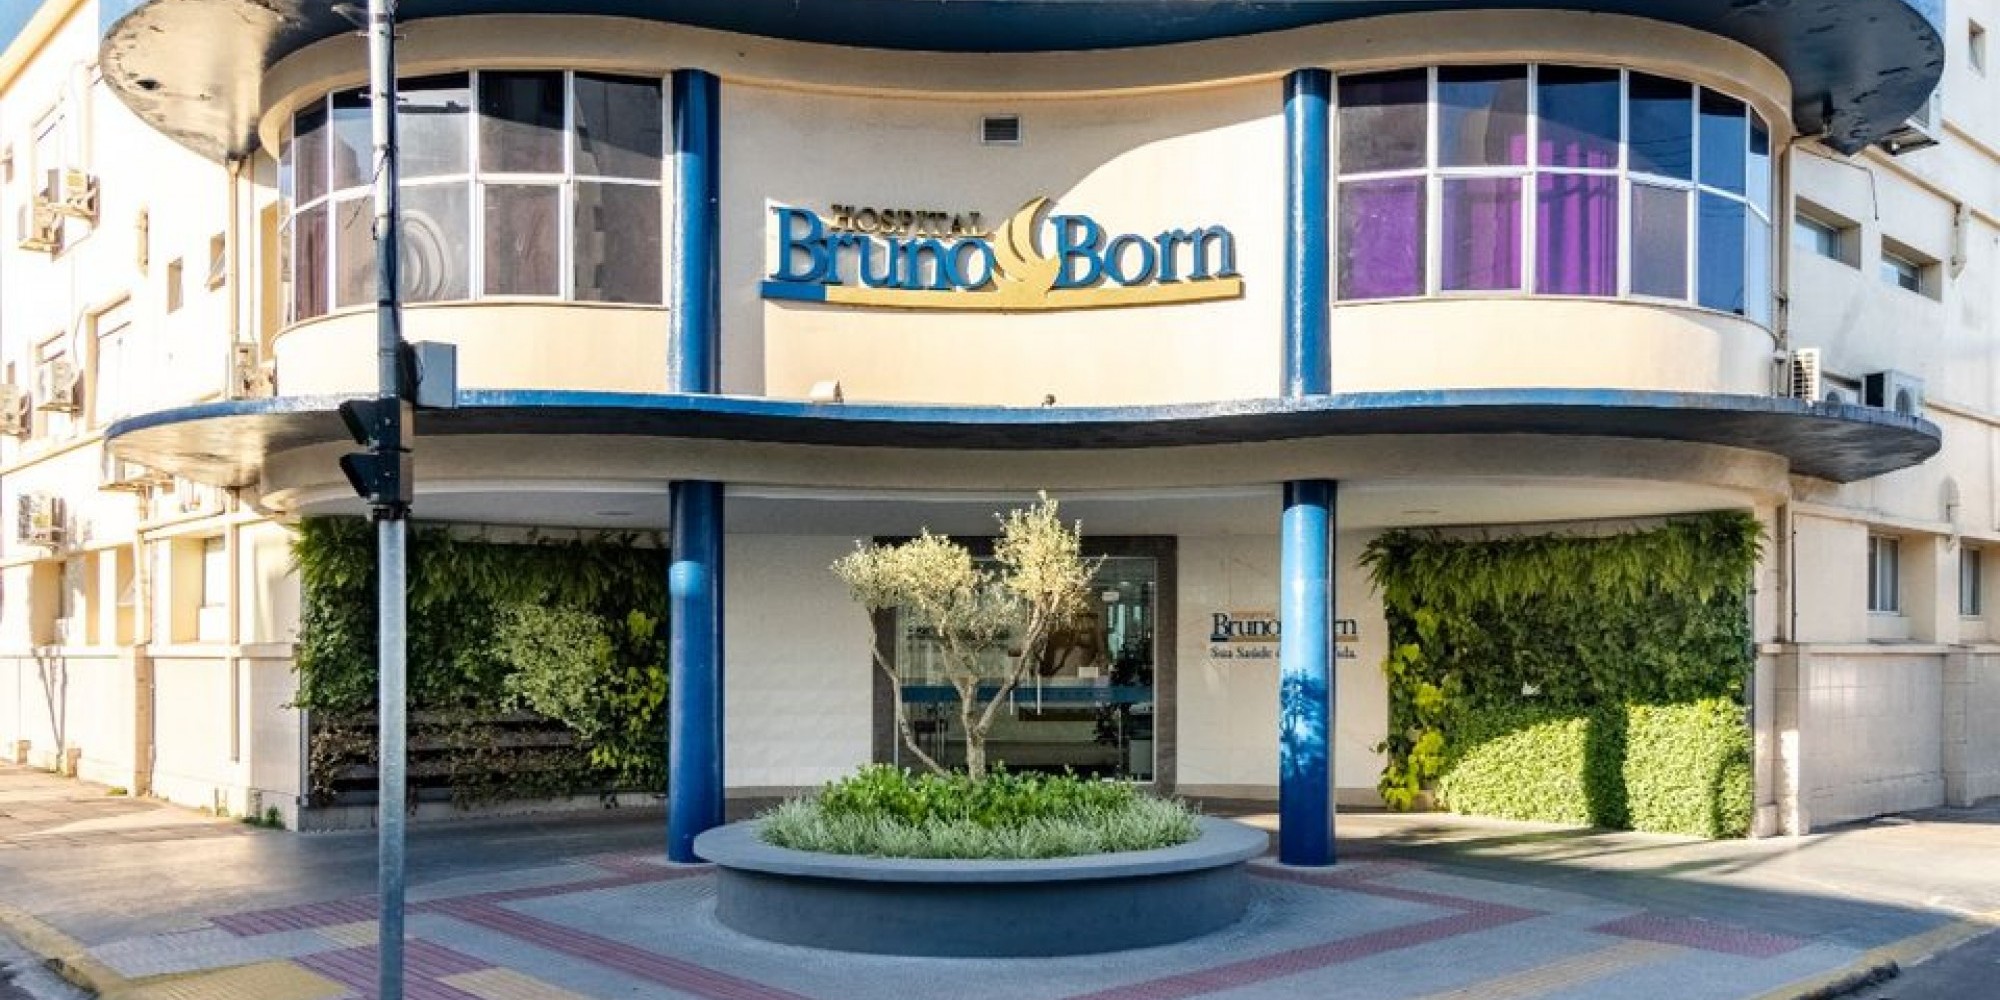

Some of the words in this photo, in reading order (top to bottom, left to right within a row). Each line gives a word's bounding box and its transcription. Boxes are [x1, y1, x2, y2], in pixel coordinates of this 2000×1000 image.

[769, 206, 997, 290] Bruno
[1050, 214, 1240, 290] Born
[830, 204, 988, 238] HOSPITAL
